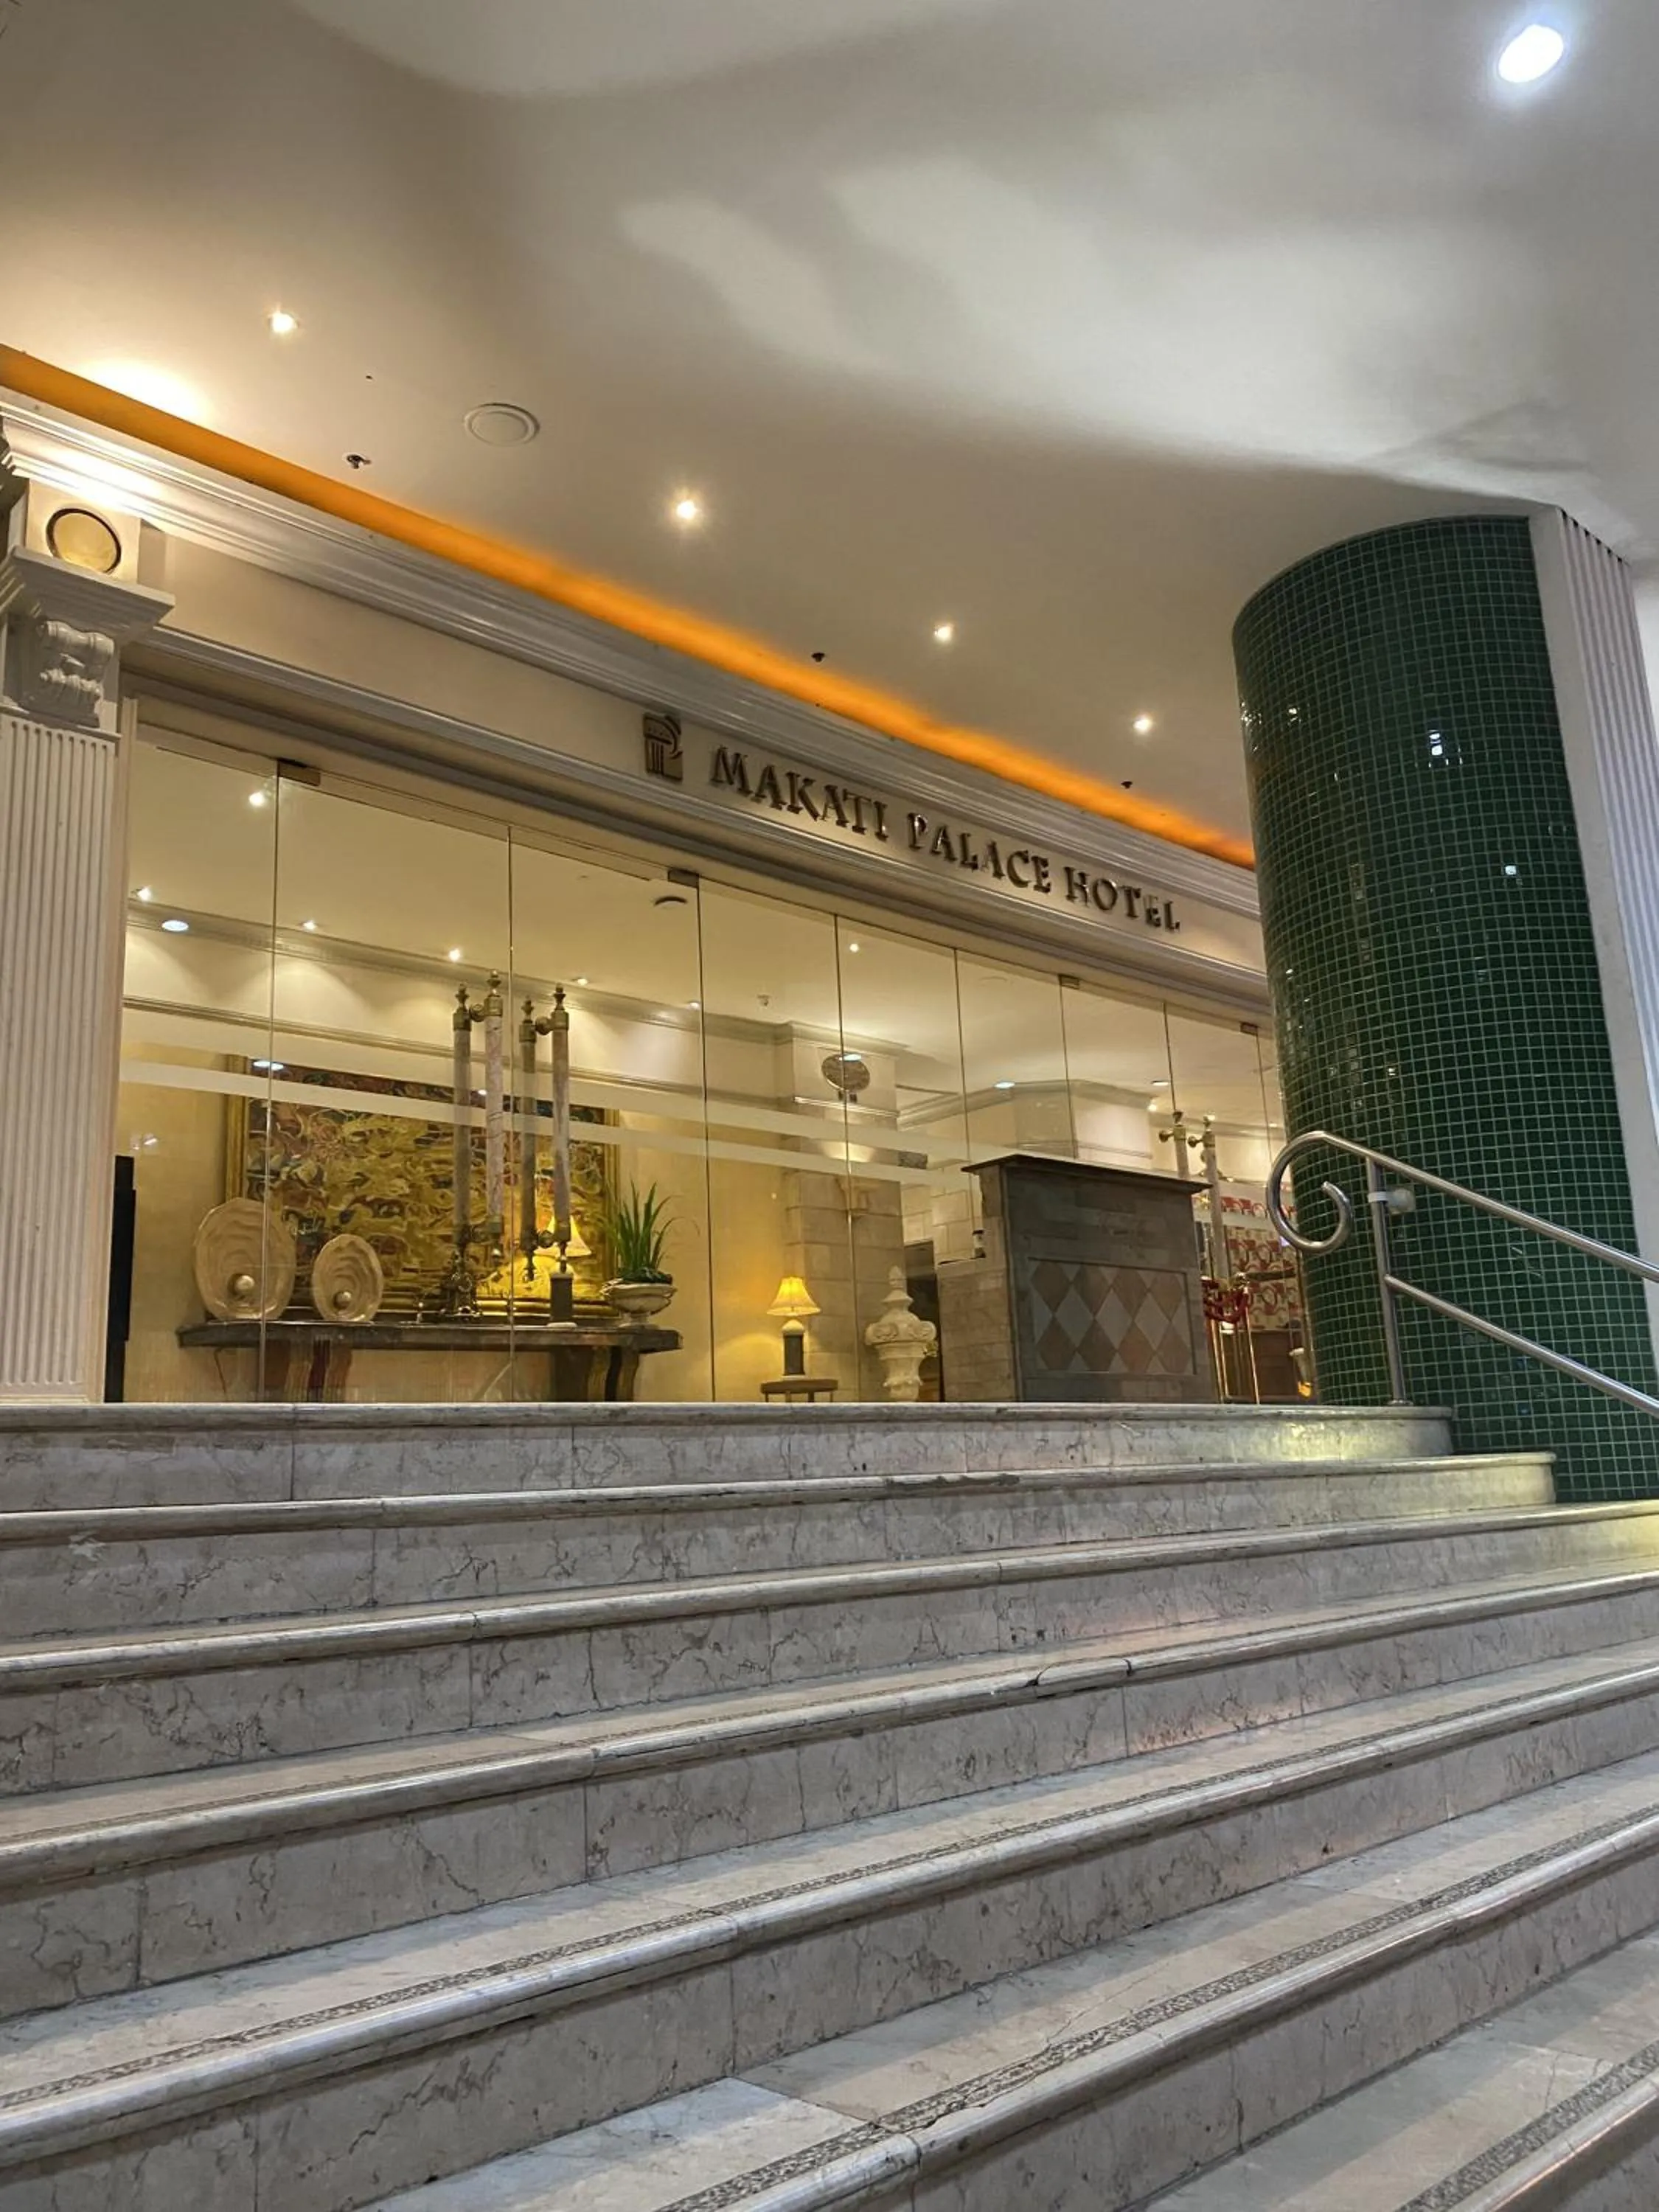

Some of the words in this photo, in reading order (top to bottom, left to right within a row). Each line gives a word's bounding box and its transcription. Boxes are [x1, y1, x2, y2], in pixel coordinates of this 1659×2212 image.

[710, 745, 889, 841] MAKATI
[907, 812, 1051, 894] PALACE
[1063, 866, 1180, 933] HOTEL
